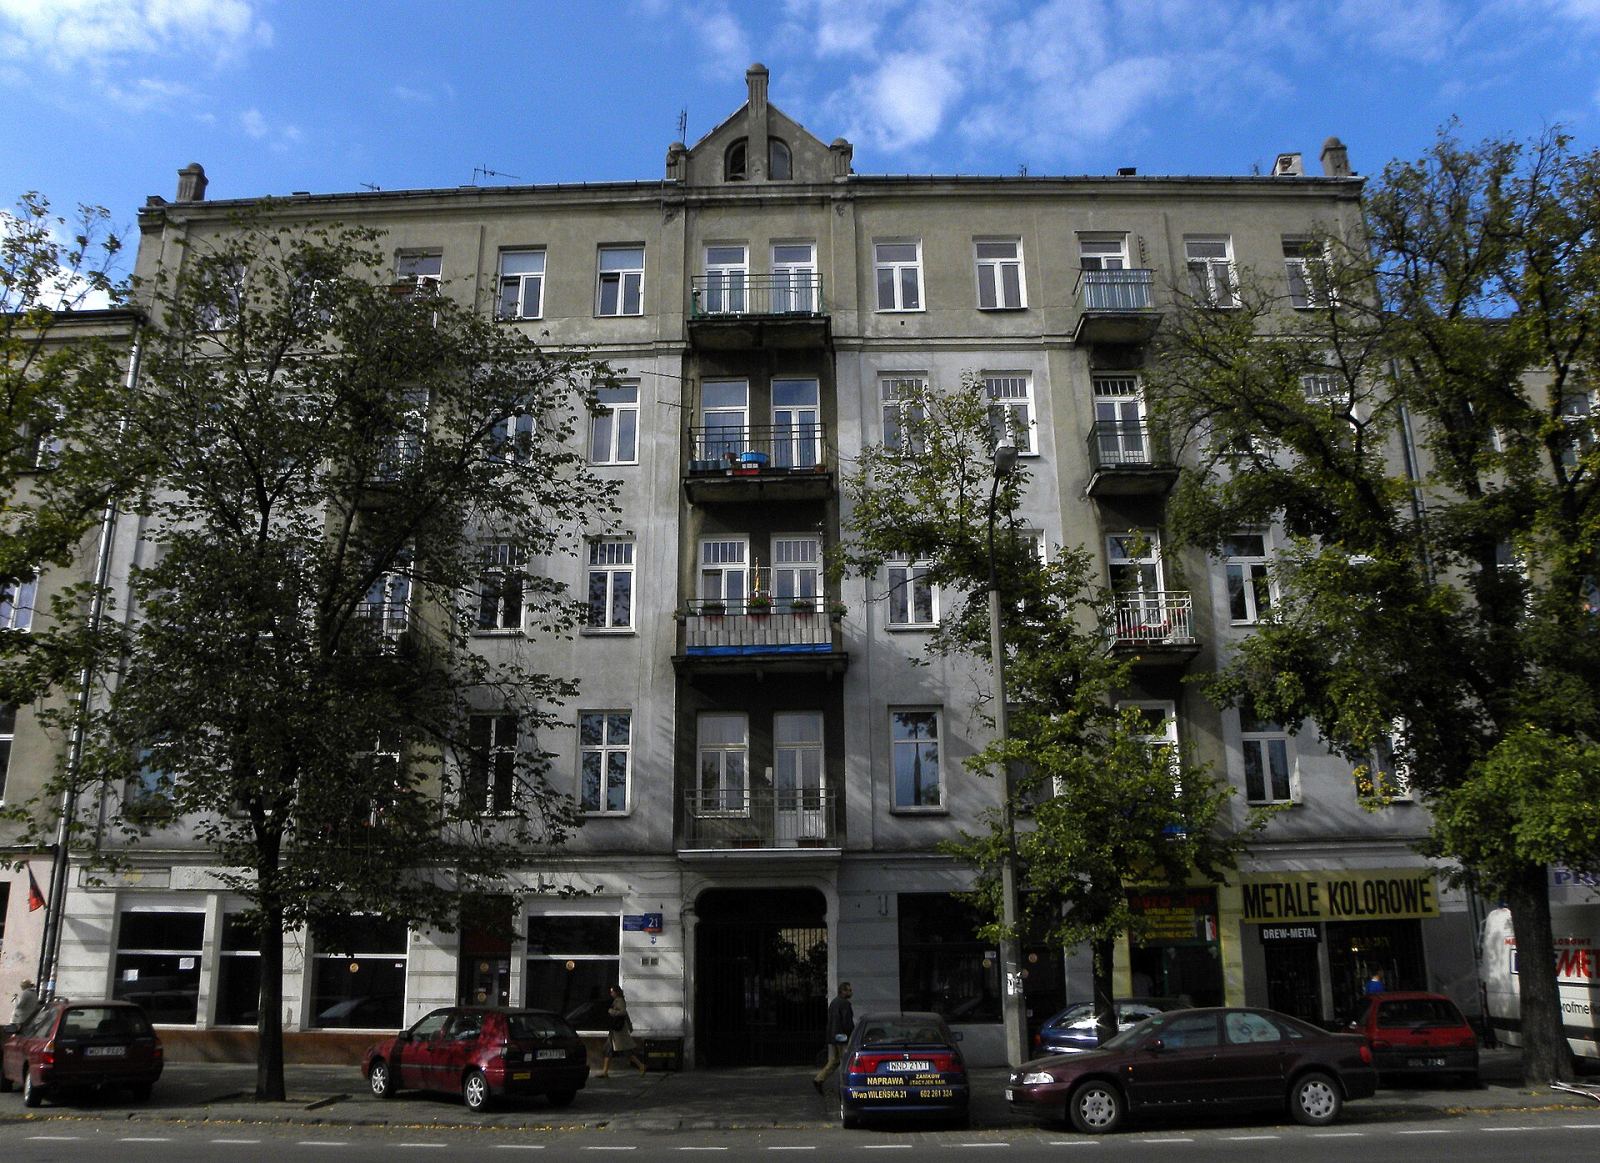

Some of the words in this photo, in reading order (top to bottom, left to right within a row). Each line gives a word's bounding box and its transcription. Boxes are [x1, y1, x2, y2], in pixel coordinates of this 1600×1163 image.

[1243, 882, 1320, 918] METALE
[1328, 879, 1433, 916] KOLOROWE
[648, 917, 658, 928] 21
[1262, 927, 1317, 940] DREW-METAL
[867, 1077, 904, 1086] NAPRAWA
[868, 1089, 899, 1099] WILEŃSKA
